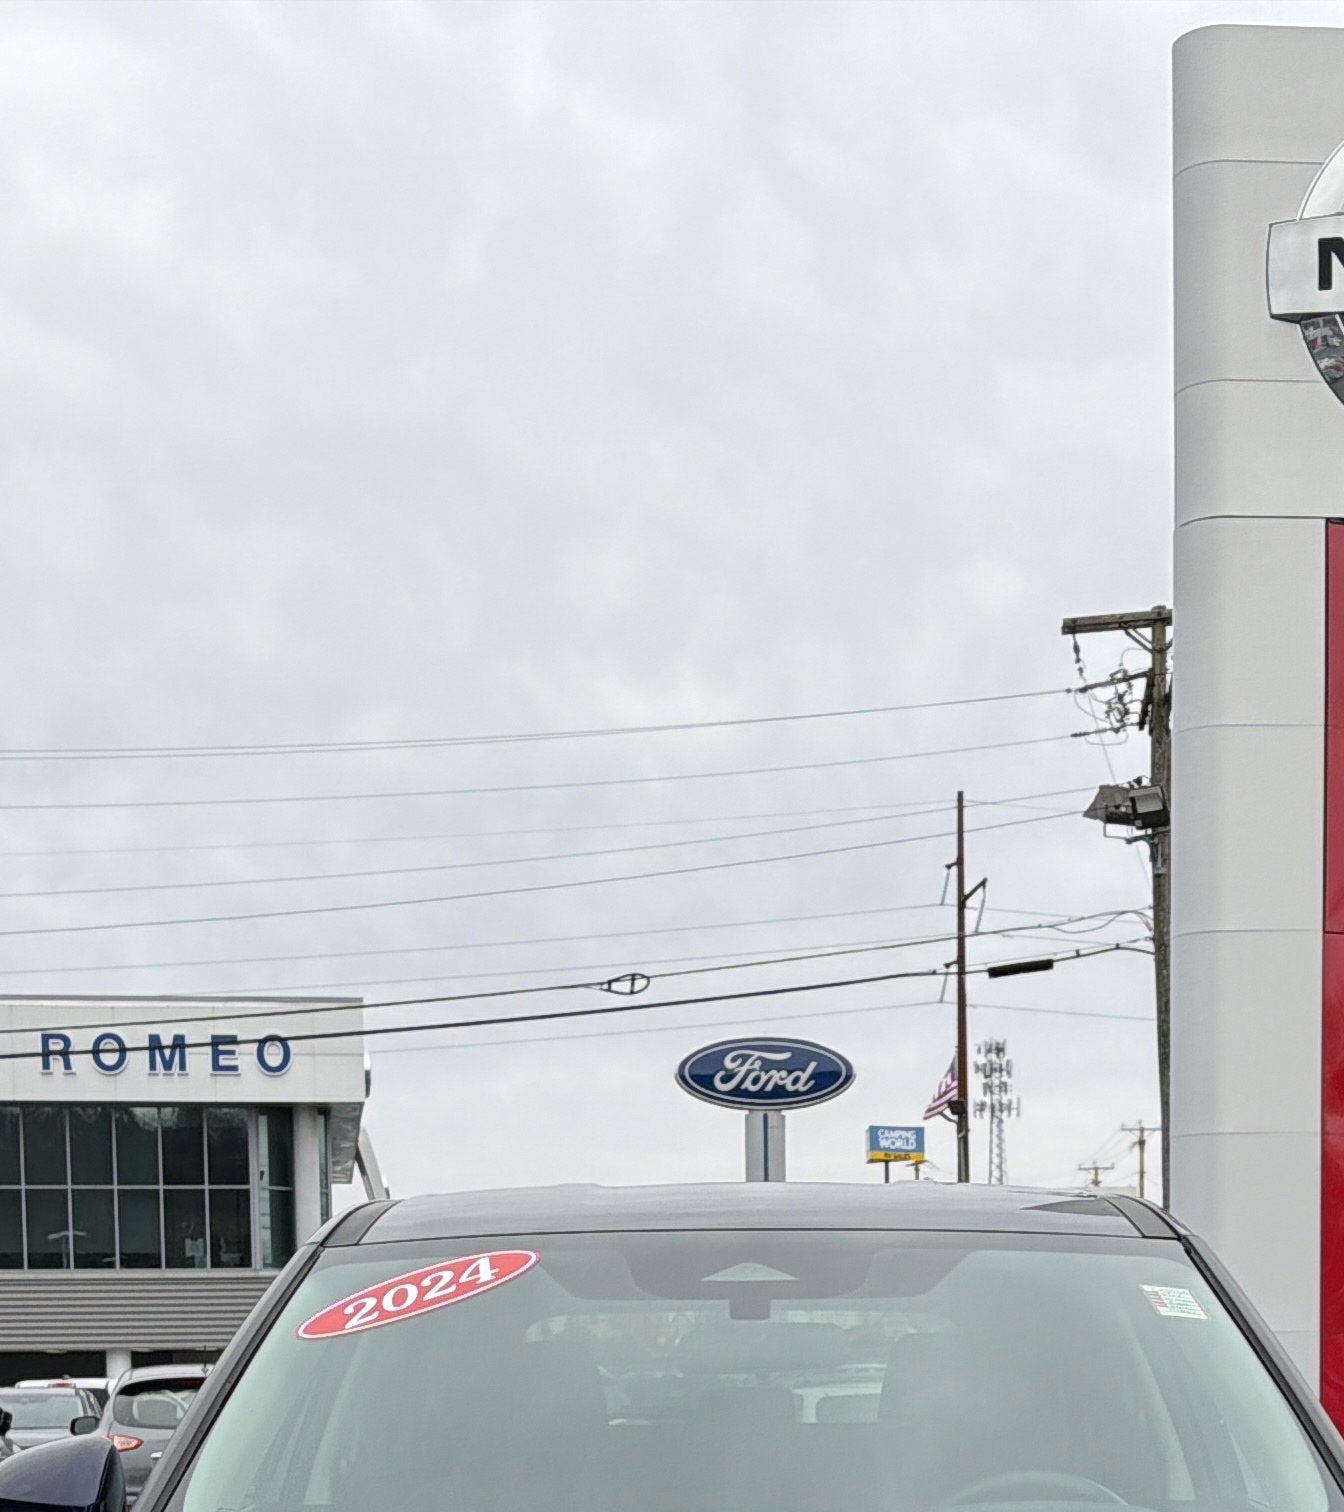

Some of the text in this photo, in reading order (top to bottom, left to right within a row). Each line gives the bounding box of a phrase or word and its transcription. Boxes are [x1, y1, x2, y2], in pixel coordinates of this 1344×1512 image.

[40, 1032, 293, 1075] ROMEO
[713, 1048, 818, 1093] Ford
[879, 1138, 916, 1150] WORLD
[343, 1256, 500, 1329] 2024
